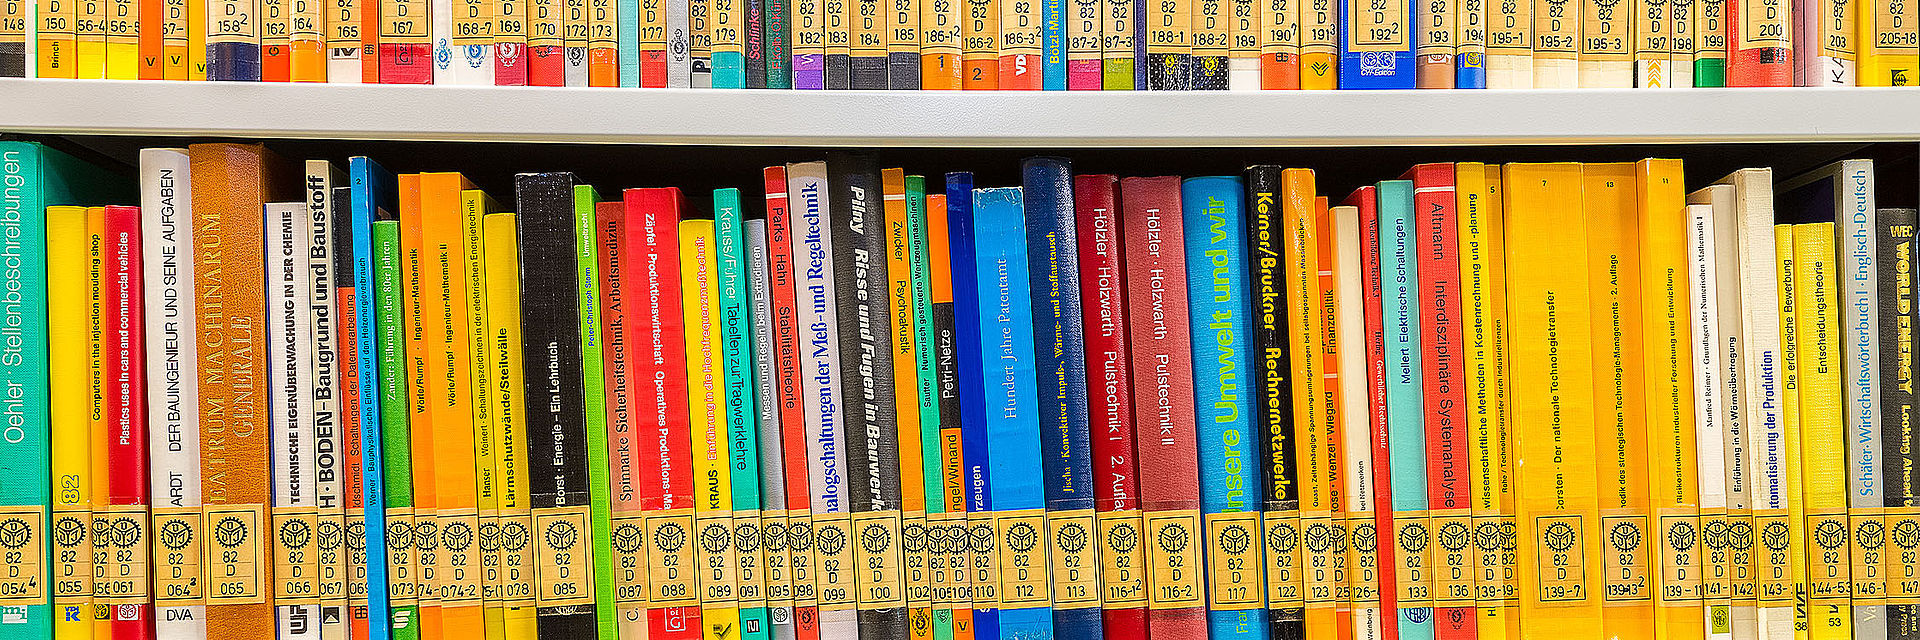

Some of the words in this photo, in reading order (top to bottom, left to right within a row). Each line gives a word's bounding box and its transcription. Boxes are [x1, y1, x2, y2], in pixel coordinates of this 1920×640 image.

[45, 18, 66, 29] 150
[861, 4, 875, 16] 82
[864, 18, 873, 29] D
[1161, 2, 1176, 13] 82
[1164, 15, 1173, 27] D
[1598, 8, 1613, 20] 82
[860, 34, 880, 46] 184
[1152, 31, 1184, 43] 188-1
[1588, 38, 1621, 49] 195-3
[1602, 22, 1611, 34] D
[160, 169, 175, 242] AUFGABEN
[308, 175, 327, 258] Baustoff
[772, 208, 783, 242] Parks
[850, 186, 865, 234] Pilny
[1202, 196, 1227, 244] wir
[1467, 194, 1480, 238] -planung
[90, 234, 100, 257] shop
[282, 212, 293, 256] CHEMIE
[581, 213, 590, 257] Umweltrecht
[645, 213, 658, 246] Zäpfel
[802, 182, 824, 280] Regeltechnik
[893, 220, 903, 261] Zwicker
[1093, 208, 1109, 258] Hölzler
[1146, 209, 1160, 258] Hölzler
[1431, 203, 1445, 261] Altmann
[0, 152, 24, 366] Stellenbeschreibungen
[119, 232, 128, 271] vehicles
[163, 246, 176, 285] SEINE
[283, 258, 293, 282] DER
[382, 241, 392, 270] Jahren
[606, 221, 622, 312] Arbeitsmedizin
[775, 254, 786, 286] Hahn
[1257, 192, 1274, 330] Kerner/Bruckner
[1394, 218, 1408, 283] Schaltungen
[1469, 241, 1479, 261] und
[90, 259, 100, 300] moulding
[284, 284, 294, 298] IN
[312, 264, 329, 300] und
[383, 272, 392, 293] 80er
[583, 267, 592, 288] Storm
[752, 247, 764, 300] Extrudieren
[855, 248, 869, 300] Risse
[995, 259, 1009, 322] Patentamt
[1205, 249, 1232, 302] und
[1781, 260, 1794, 313] Bewerbung
[1897, 241, 1910, 313] WORLD
[119, 273, 128, 328] commercial
[165, 288, 177, 317] UND
[202, 213, 224, 384] MACHINARUM
[384, 296, 393, 311] den
[409, 248, 423, 341] Ingenieur-Mathematik
[439, 252, 454, 344] Ingenieur-Mathematik
[648, 253, 662, 365] Produktionswirtschaft
[695, 236, 712, 372] Hochfrequenzmeßtechnik
[756, 303, 766, 326] beim
[1098, 267, 1114, 337] Holzwarth
[1150, 269, 1166, 340] Holzwarth
[1470, 263, 1485, 348] Kostenrechnung
[91, 302, 100, 341] injection
[385, 314, 393, 322] in
[585, 290, 595, 347] Peter-Christoph
[726, 303, 743, 355] Tabellen
[857, 304, 871, 339] und
[896, 280, 910, 354] Psychoakustik
[1396, 287, 1409, 343] Elektrische
[1812, 262, 1828, 374] Entscheidungstheorie
[119, 331, 128, 349] and
[344, 294, 357, 377] Datenverarbeitung
[384, 325, 396, 363] Führung
[757, 328, 769, 361] Regeln
[1000, 327, 1018, 361] Jahre
[1434, 281, 1452, 393] Interdisziplinäre
[1474, 351, 1483, 360] in
[1546, 291, 1560, 393] Technologietransfer
[1783, 316, 1796, 371] erfolgreiche
[92, 360, 100, 368] in
[120, 350, 129, 371] cars
[165, 322, 180, 421] BAUINGENIEUR
[231, 316, 254, 437] GENERALE
[284, 300, 298, 429] EIGENÜBERWACHUNG
[547, 342, 560, 393] Lehrbuch
[611, 315, 628, 433] Sicherheitstechnik,
[731, 357, 741, 377] zur
[759, 364, 769, 381] und
[779, 306, 794, 408] Stabilitätstheorie
[816, 362, 830, 384] der
[858, 341, 874, 388] Fugen
[940, 329, 954, 399] Petri-Netze
[1210, 310, 1238, 423] Umwelt
[1398, 348, 1411, 384] Mellert
[1898, 318, 1913, 395] ENERGY
[92, 371, 101, 421] Computers
[120, 373, 129, 381] in
[120, 383, 129, 406] uses
[311, 305, 335, 482] BODEN-Baugrund
[348, 380, 358, 396] der
[386, 365, 396, 401] Zander:
[414, 356, 426, 413] Wörle/Rumpf
[444, 351, 456, 406] Wörle/Rumpf
[703, 374, 713, 389] die
[704, 392, 714, 402] in
[1003, 365, 1017, 419] Hundert
[1104, 351, 1121, 431] Pulstechnik
[1156, 354, 1174, 435] Pulstechnik
[1475, 364, 1487, 414] Methoden
[1726, 337, 1741, 421] Wärmeübertragung
[1760, 351, 1775, 408] Produktion
[1785, 374, 1797, 390] Die
[4, 380, 24, 443] Oehler
[498, 328, 516, 508] Lärmschutzwände/Steilwälle
[548, 395, 560, 412] Ein
[655, 371, 667, 426] Operatives
[761, 383, 772, 420] Messen
[865, 402, 876, 421] in
[120, 407, 129, 445] Plastics
[168, 424, 182, 451] DER
[349, 398, 361, 456] Schaltungen
[704, 404, 717, 461] Einführung
[730, 378, 746, 470] Tragwerklehre
[1265, 347, 1290, 499] Rechnernetzwerke
[1549, 396, 1562, 442] nationale
[1730, 422, 1740, 435] die
[1764, 411, 1777, 430] der
[552, 424, 565, 465] Energie
[1110, 455, 1123, 468] 2.
[1440, 399, 1456, 508] Systemanalyse
[1552, 445, 1563, 464] Der
[1731, 437, 1740, 446] in
[288, 432, 300, 504] TECHNISCHE
[482, 468, 491, 498] Hanser
[618, 437, 633, 501] Spinnarke
[1732, 448, 1743, 493] Einführung
[707, 470, 720, 510] KRAUS
[61, 551, 76, 562] 82
[64, 564, 73, 576] D
[555, 553, 570, 566] 82
[560, 566, 569, 578] D
[1014, 555, 1029, 566] 82
[1019, 569, 1027, 580] D
[1227, 558, 1243, 570] 82
[1553, 554, 1568, 566] 82
[1557, 568, 1566, 580] D
[59, 581, 82, 593] 055
[553, 583, 576, 595] 085
[1016, 585, 1034, 597] 112
[1227, 587, 1246, 599] 117
[1232, 571, 1241, 584] D
[1544, 585, 1581, 598] 139-7
[167, 609, 193, 621] DVA
